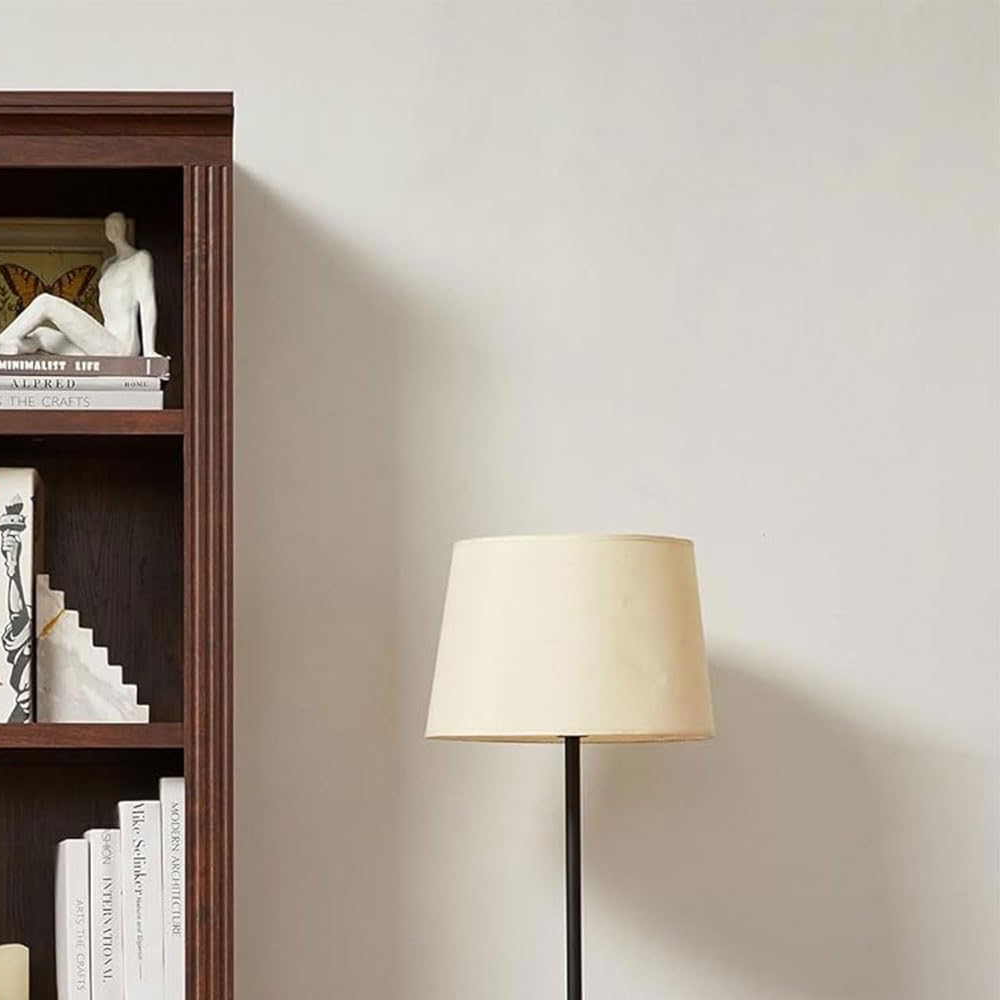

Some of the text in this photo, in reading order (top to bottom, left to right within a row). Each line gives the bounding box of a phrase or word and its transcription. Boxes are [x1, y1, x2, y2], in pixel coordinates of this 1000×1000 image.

[10, 378, 77, 389] ALPRED
[75, 361, 100, 371] LIFE
[10, 396, 34, 407] THE
[41, 396, 90, 407] CRAFTS
[131, 803, 147, 835] Mike
[132, 839, 147, 895] Selinker
[170, 802, 181, 936] MODERN ARCHITECTURE
[75, 899, 87, 991] ARTS THE CRAFTS
[102, 877, 113, 983] INTERNATIONAL
